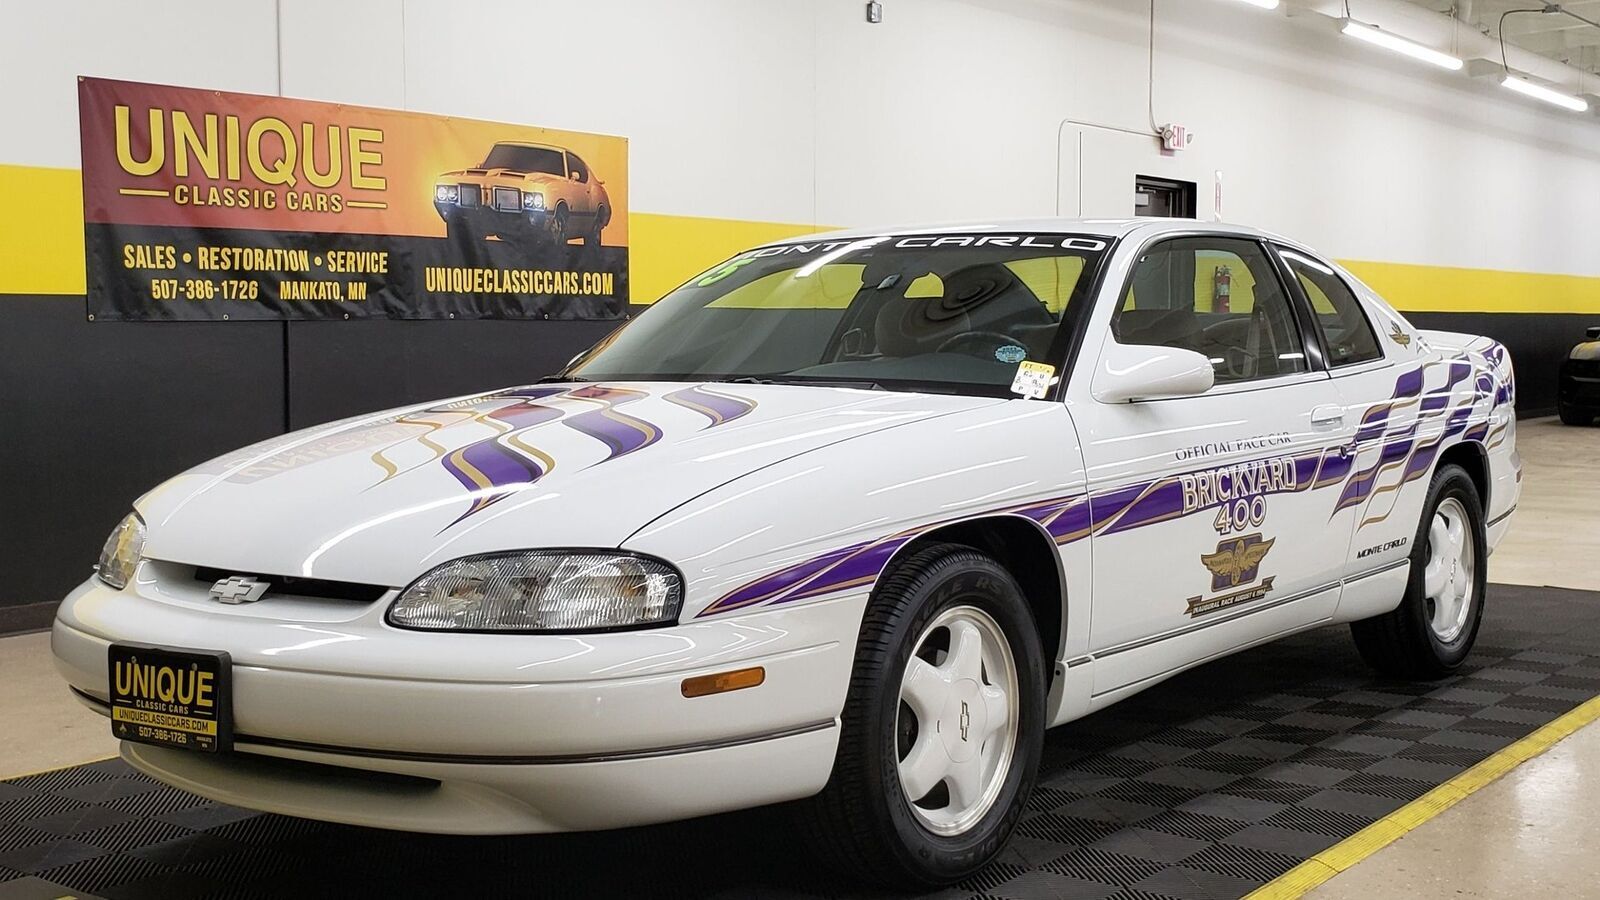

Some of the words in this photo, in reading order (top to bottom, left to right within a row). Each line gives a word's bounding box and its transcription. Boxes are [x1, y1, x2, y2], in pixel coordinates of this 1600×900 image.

[114, 104, 387, 190] UNIQUE
[1173, 125, 1185, 148] EXIT
[174, 184, 278, 210] CLASSIC
[286, 191, 344, 213] CARS
[895, 236, 1107, 251] CARLO
[124, 244, 177, 270] SALES
[197, 246, 310, 272] RESTORATION
[327, 250, 389, 274] SERVICE
[151, 278, 259, 300] 507-386-1726
[279, 280, 345, 303] MANKATO,
[348, 282, 368, 301] MN
[425, 267, 614, 296] UNIQUECLASSICCARS.COM
[1175, 443, 1232, 461] OFFICIAL
[1236, 435, 1266, 451] PACE
[1268, 431, 1292, 446] CAR
[1180, 457, 1296, 514] BRICKYARD
[1213, 495, 1268, 535] 400
[1357, 545, 1383, 559] MONTE
[1383, 537, 1407, 551] CARLO
[1221, 596, 1235, 607] RACE
[1235, 592, 1252, 602] AUGUST
[115, 661, 214, 707] UNIQUE
[119, 709, 209, 732] UNIQUECLASSICCARS.COM
[136, 699, 167, 712] CLASSIC
[168, 704, 189, 715] CARS
[138, 726, 187, 744] 507-386-1726
